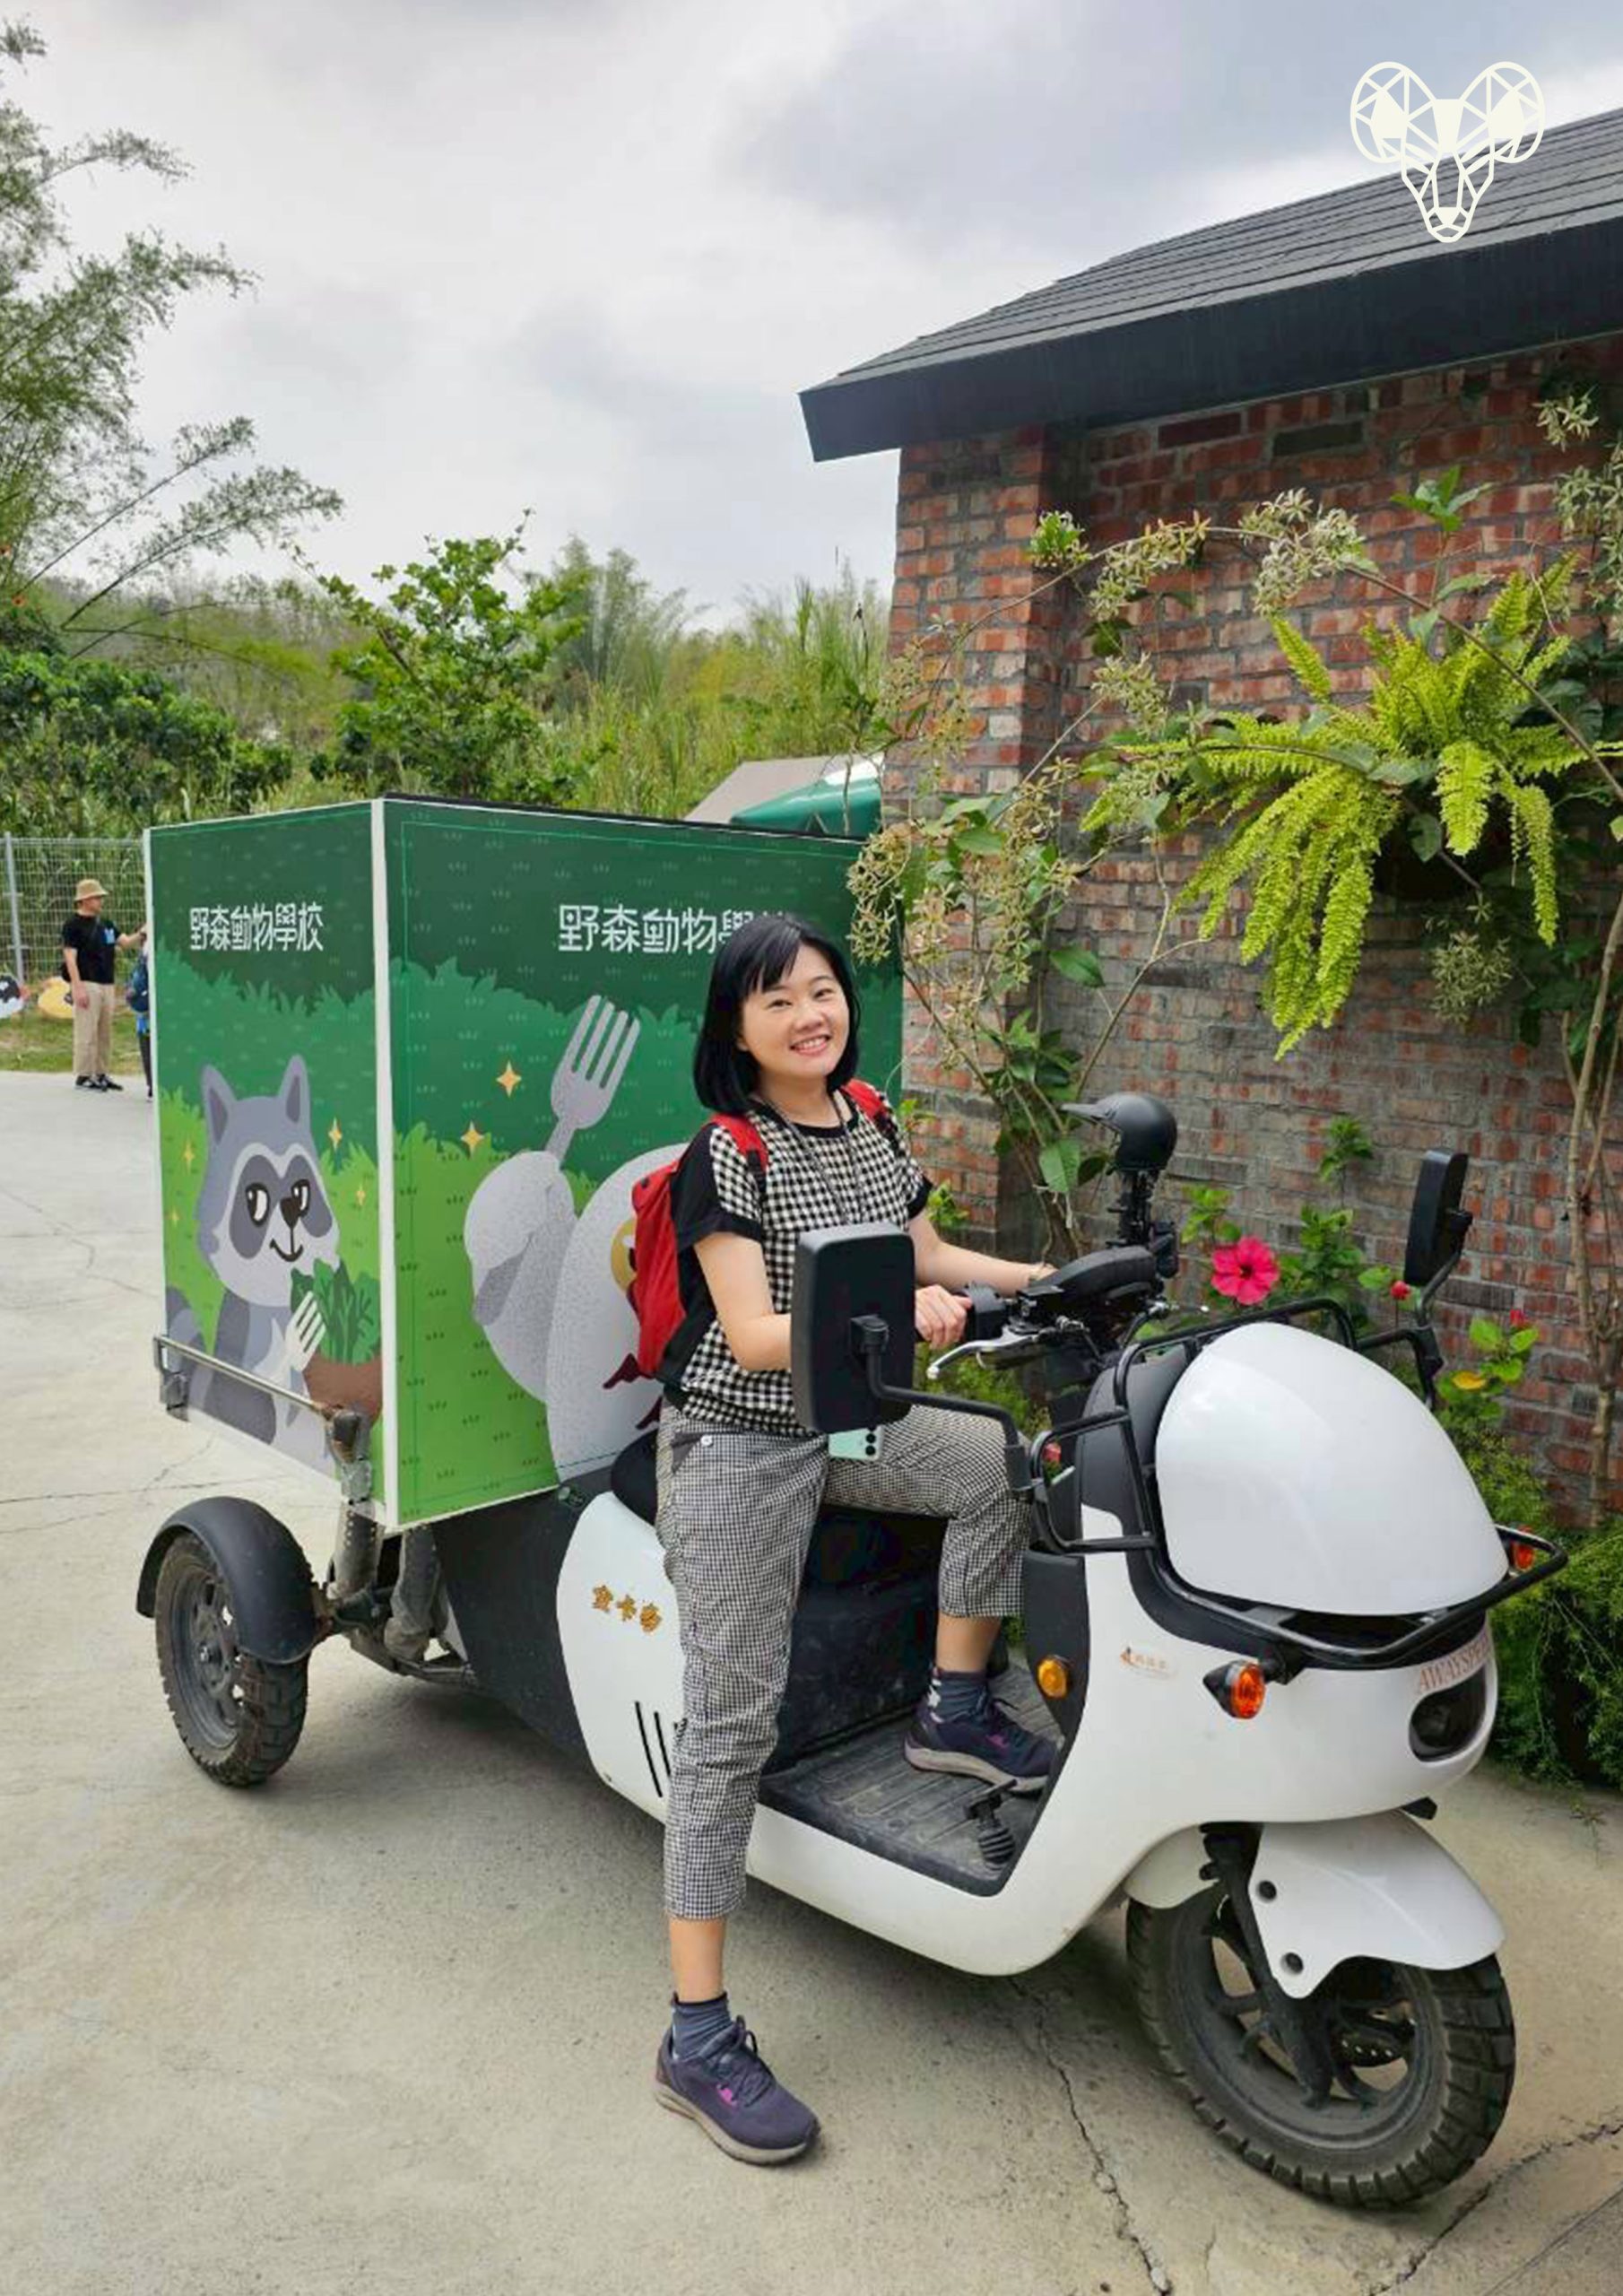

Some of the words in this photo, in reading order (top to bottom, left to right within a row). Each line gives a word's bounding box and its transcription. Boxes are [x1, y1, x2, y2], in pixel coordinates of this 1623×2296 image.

[190, 901, 324, 951] 野森動物學校
[559, 905, 784, 953] 野森動物學
